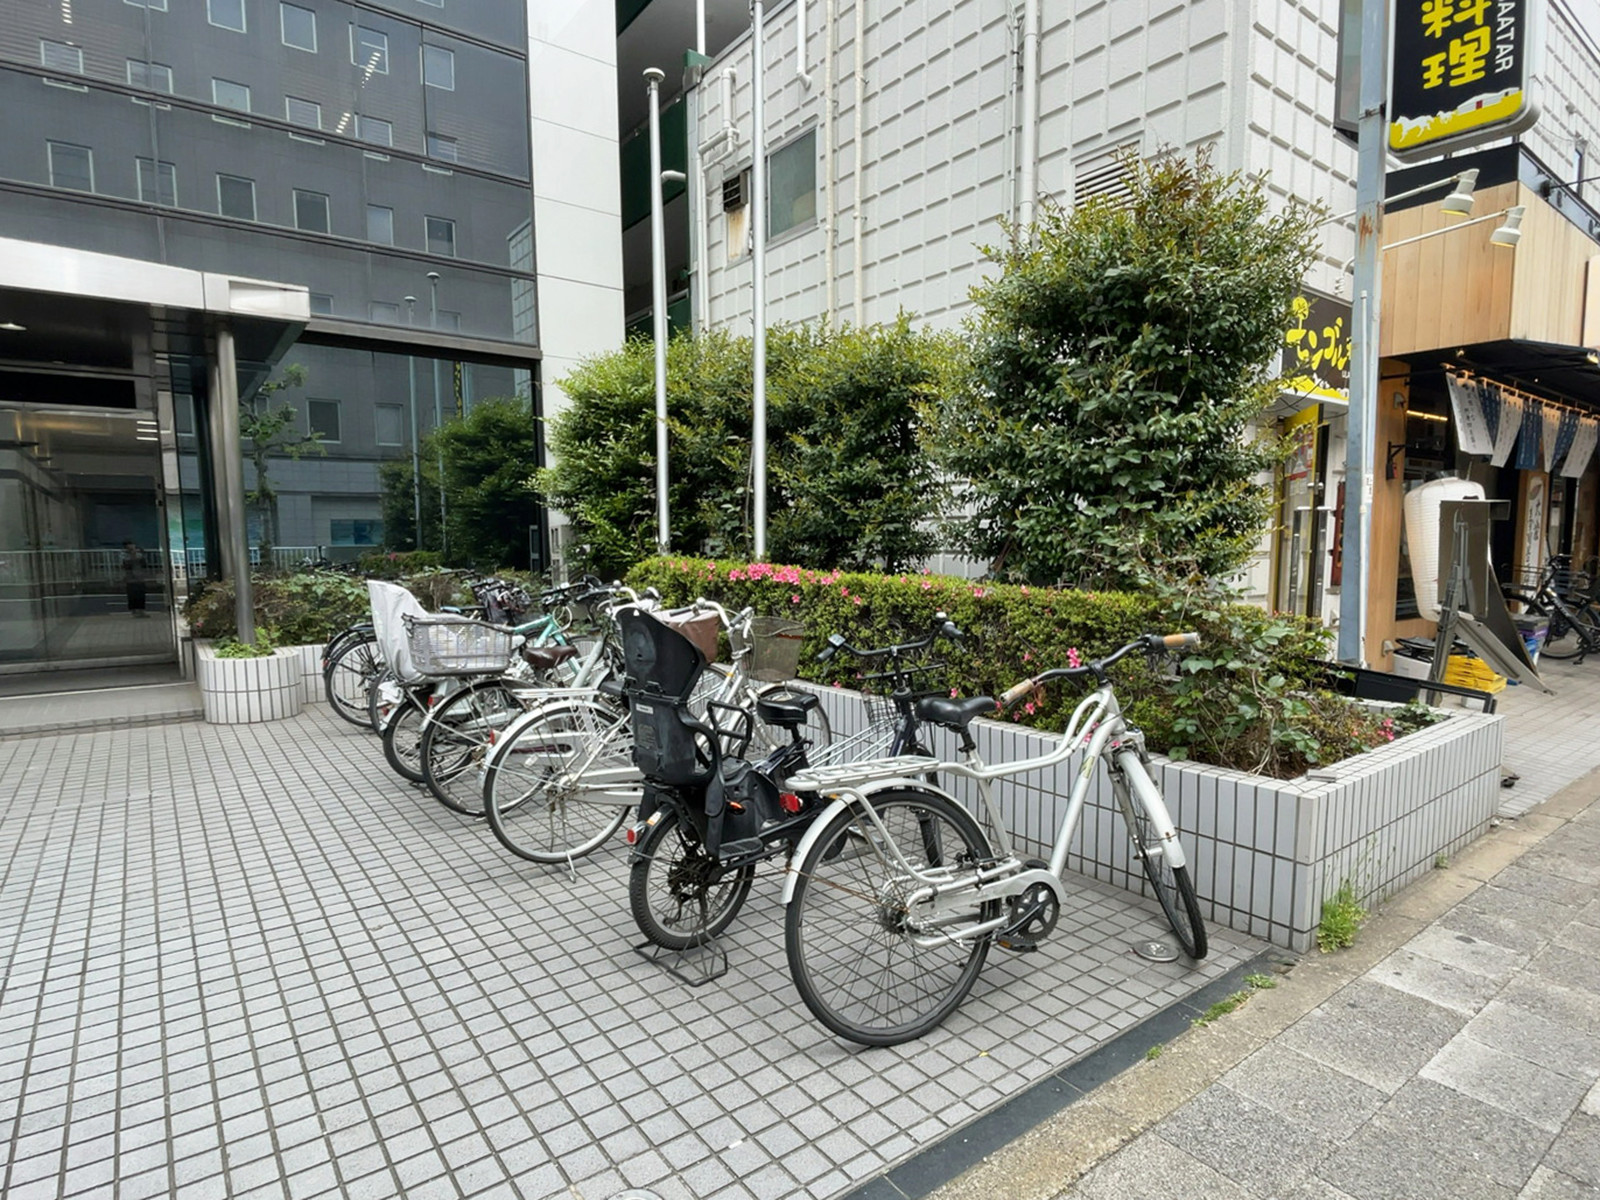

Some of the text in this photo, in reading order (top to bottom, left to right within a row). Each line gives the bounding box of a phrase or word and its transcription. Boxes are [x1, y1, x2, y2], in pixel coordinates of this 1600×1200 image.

[1421, 0, 1492, 89] 料理
[1494, 0, 1516, 73] AATAR
[1286, 296, 1351, 370] モンゴル
